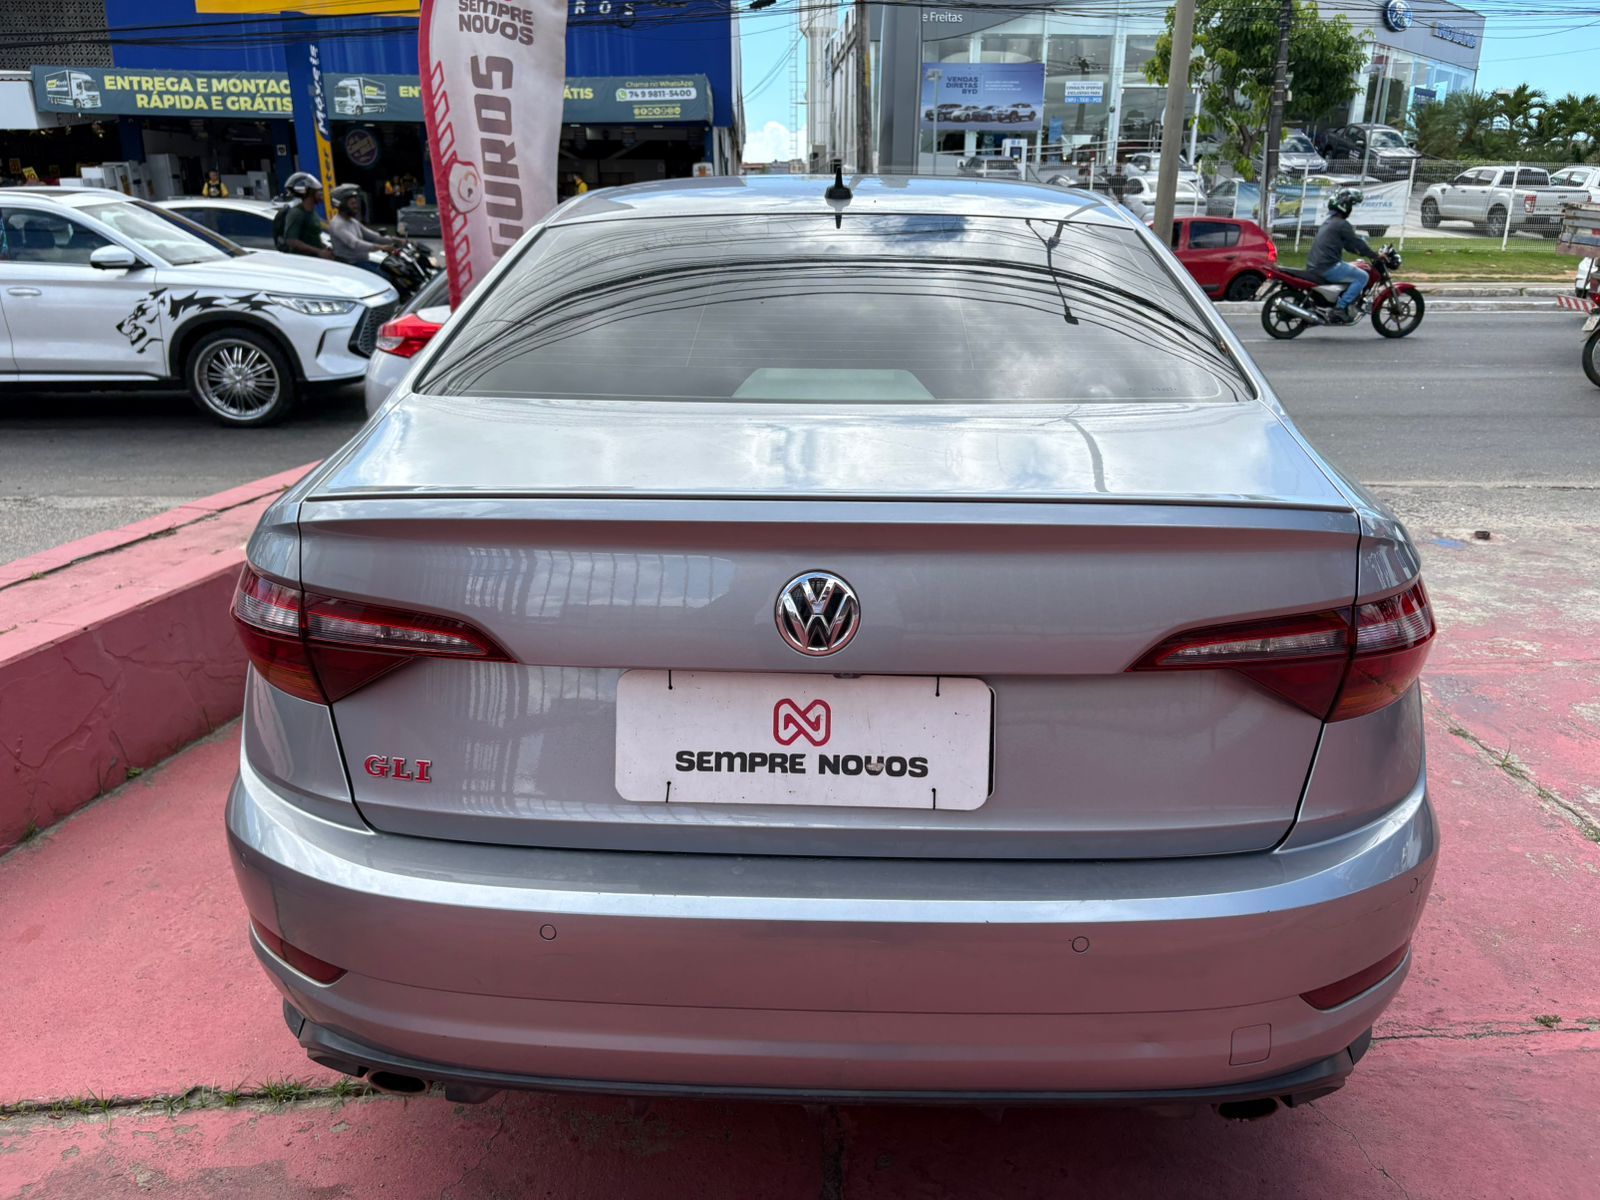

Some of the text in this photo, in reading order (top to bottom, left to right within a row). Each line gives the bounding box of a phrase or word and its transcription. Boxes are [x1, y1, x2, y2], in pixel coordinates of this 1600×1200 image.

[458, 0, 534, 26] SEMPRE
[930, 11, 963, 22] Freitas
[458, 14, 534, 46] NOVOS
[103, 75, 194, 92] ENTREGA
[196, 78, 208, 92] E
[628, 90, 639, 98] 74
[659, 80, 694, 89] WhatsApp
[136, 91, 293, 112] RÁPIDA E GRÁTIS
[364, 755, 432, 783] GLI
[675, 750, 928, 778] SEMPRE NOVOS
